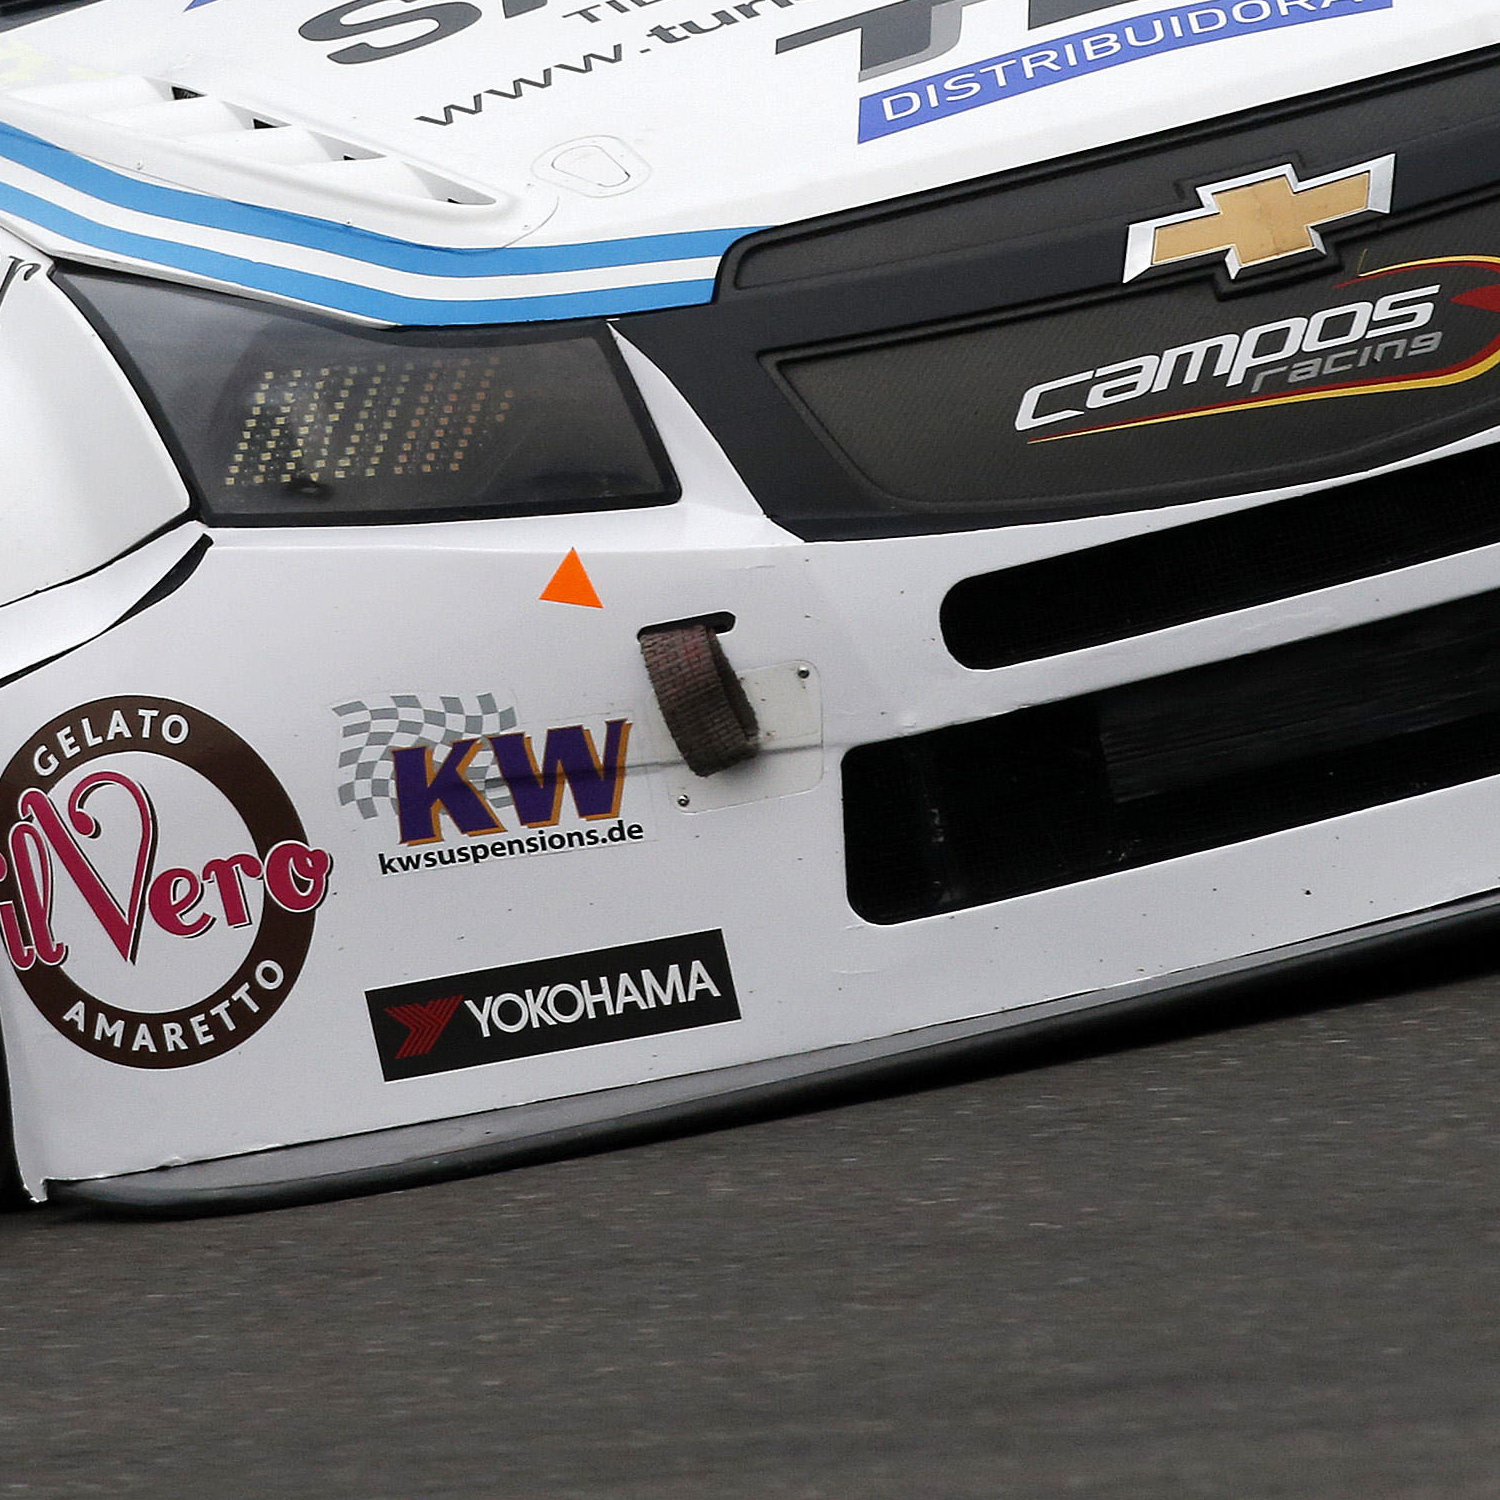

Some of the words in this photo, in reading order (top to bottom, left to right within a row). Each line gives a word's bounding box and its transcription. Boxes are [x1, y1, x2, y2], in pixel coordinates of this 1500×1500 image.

[1013, 284, 1442, 432] campos
[1251, 330, 1444, 394] racing
[33, 707, 191, 776] GELATO
[391, 718, 634, 846] KW
[377, 818, 645, 876] kwsuspensions.de
[61, 958, 287, 1054] AMARETTO
[463, 957, 723, 1039] YOKOHAMA
